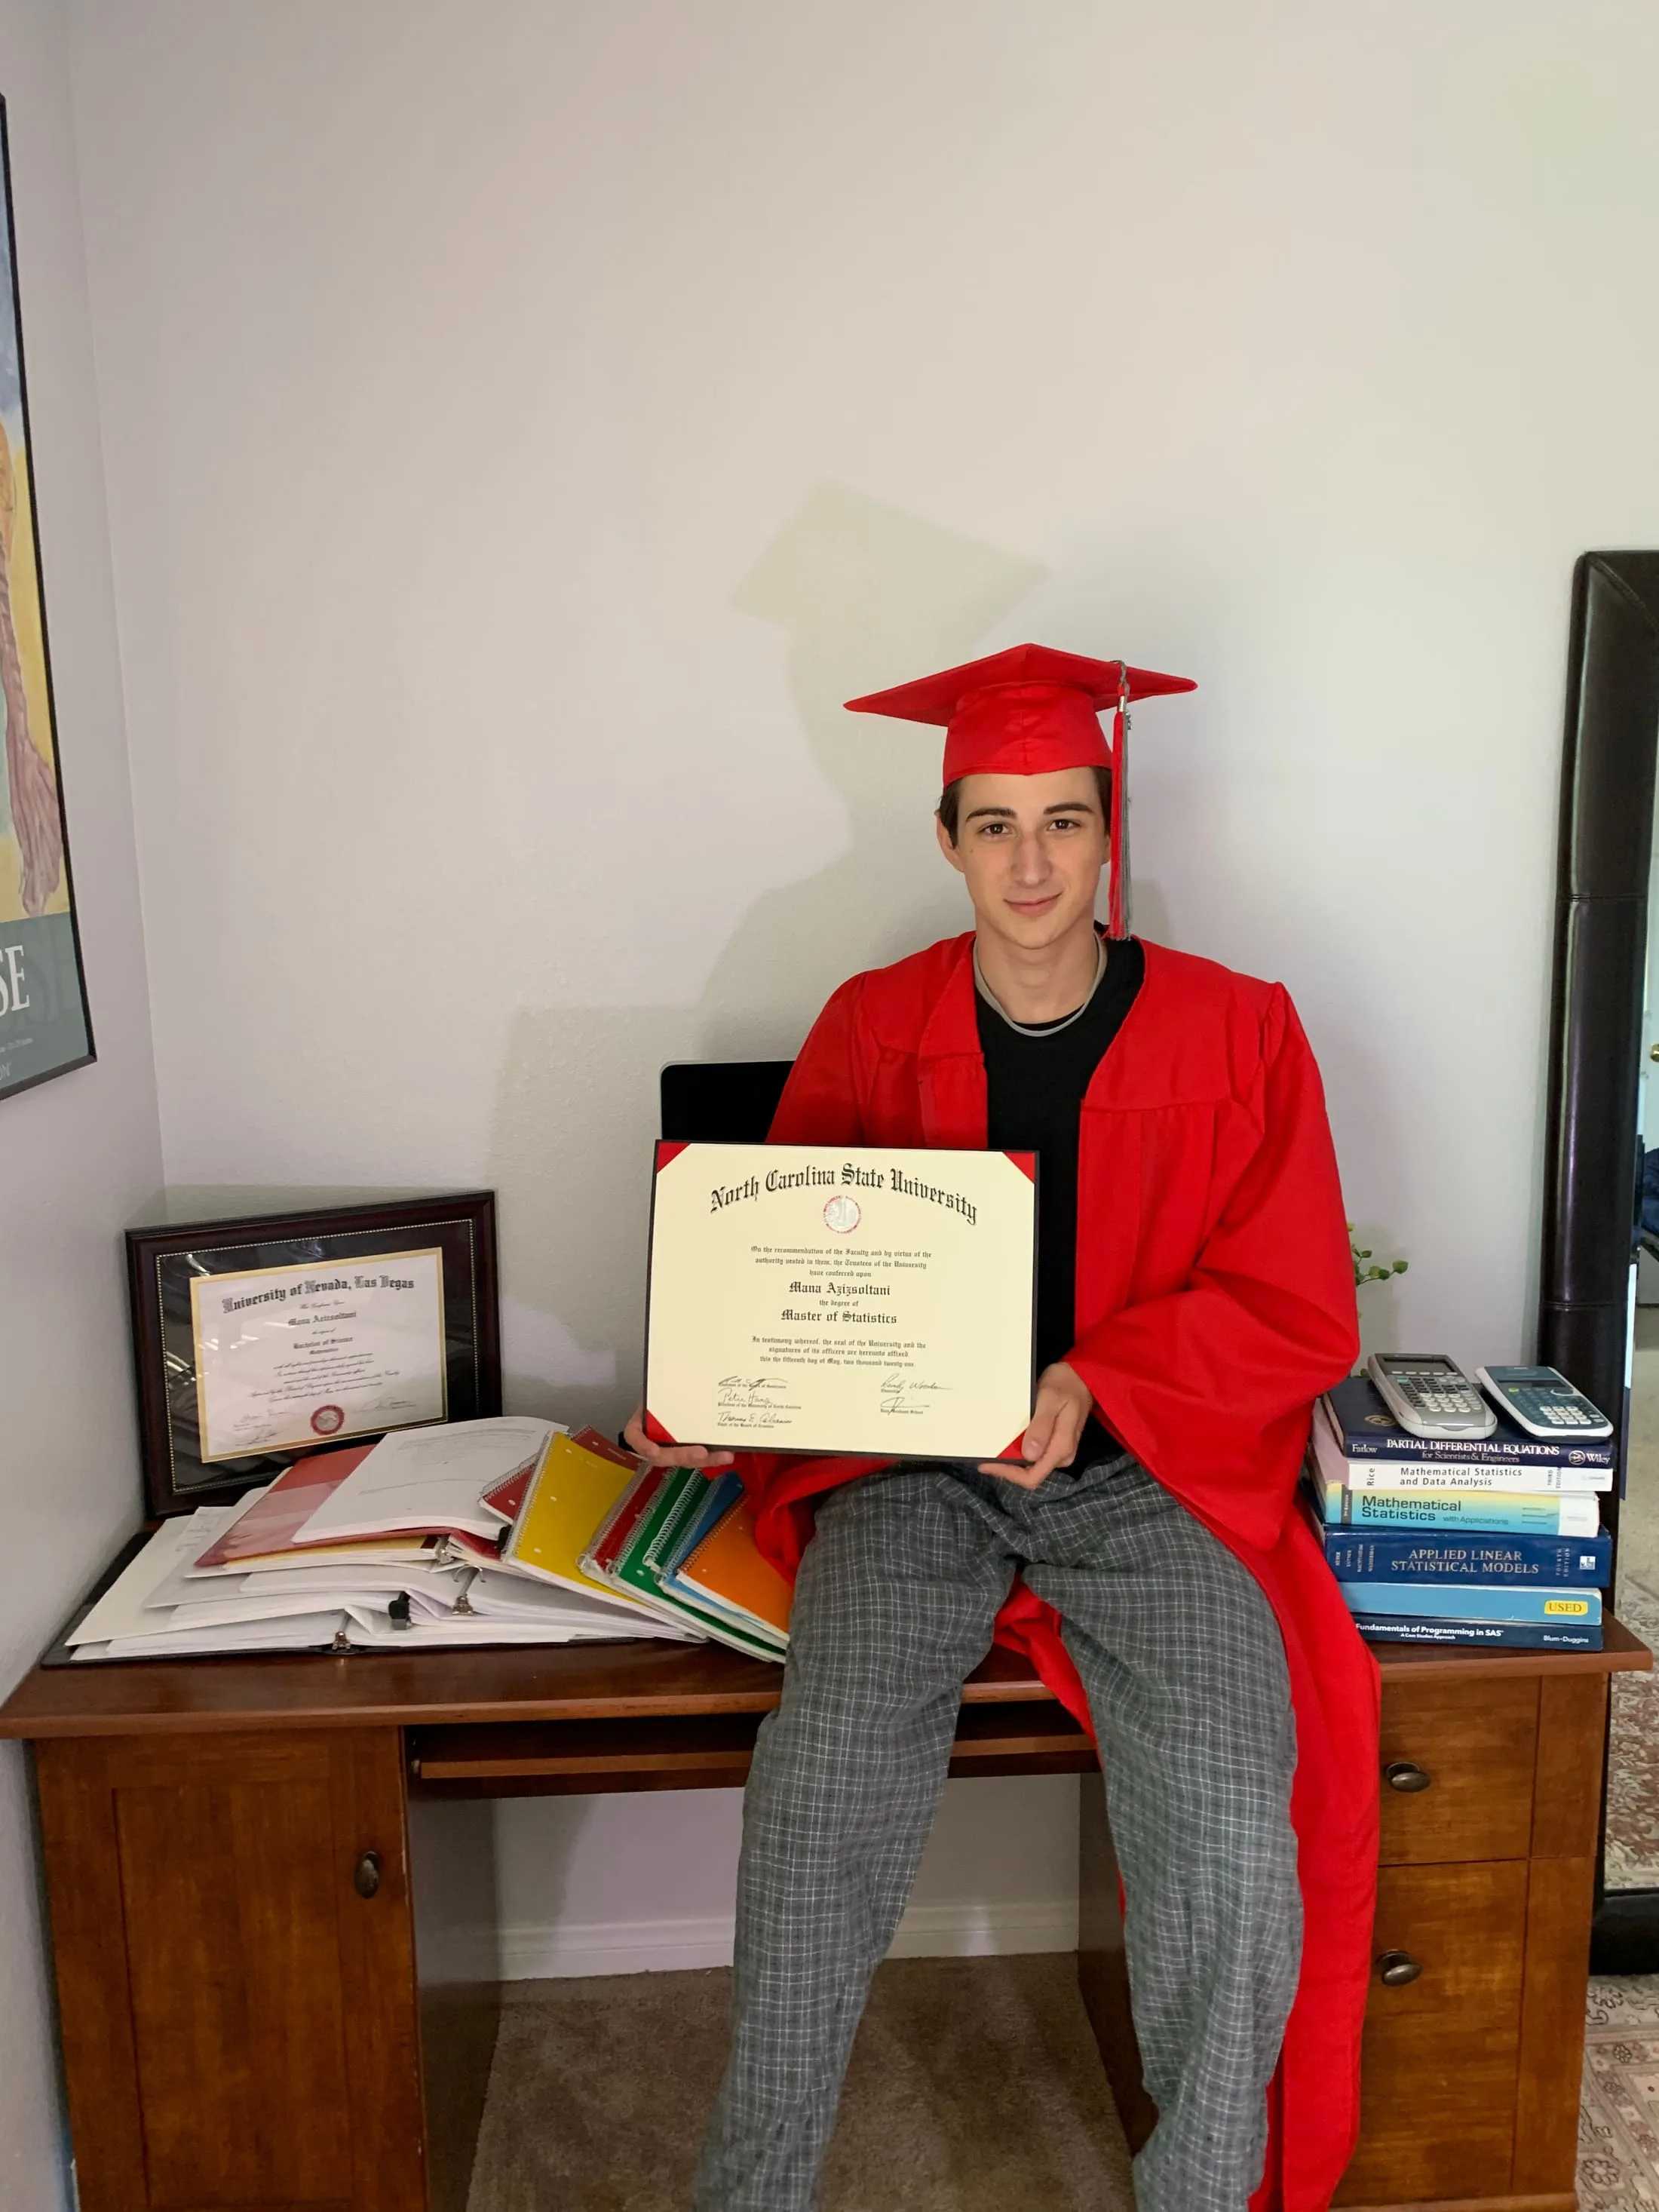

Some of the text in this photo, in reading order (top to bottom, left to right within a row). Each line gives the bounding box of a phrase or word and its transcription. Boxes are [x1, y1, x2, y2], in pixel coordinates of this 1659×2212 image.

[710, 1175, 759, 1213] North
[765, 1164, 835, 1192] Carolina
[841, 1162, 885, 1189] State
[891, 1168, 977, 1226] University
[884, 1250, 892, 1258] by
[894, 1260, 927, 1269] University
[222, 1288, 286, 1314] University
[290, 1283, 303, 1296] of
[305, 1278, 352, 1294] Nevada,
[354, 1275, 377, 1288] Las
[379, 1275, 414, 1290] Vegas
[789, 1281, 891, 1296] Mana Azizsoltani
[781, 1309, 897, 1324] Master of Statistics
[869, 1339, 901, 1348] University
[1387, 1439, 1559, 1456] PARTIAL DIFFERENTIAL EQUATIONS
[1435, 1452, 1470, 1461] Scientists
[1471, 1452, 1480, 1461] &
[1482, 1453, 1519, 1464] Engineers
[1587, 1453, 1611, 1465] Wiley
[1366, 1468, 1375, 1486] Rice
[1400, 1467, 1522, 1477] Mathematical Statistics
[1400, 1477, 1492, 1488] and Data Analysis
[1362, 1496, 1461, 1512] Mathematical
[1362, 1506, 1436, 1521] Statistics
[1460, 1516, 1509, 1525] Applications
[1408, 1549, 1522, 1561] APPLIED LINEAR
[1391, 1560, 1539, 1574] STATISTICAL MODELS
[1549, 1602, 1582, 1612] USED
[1355, 1623, 1410, 1633] Fundamentals
[1421, 1626, 1475, 1637] Programming
